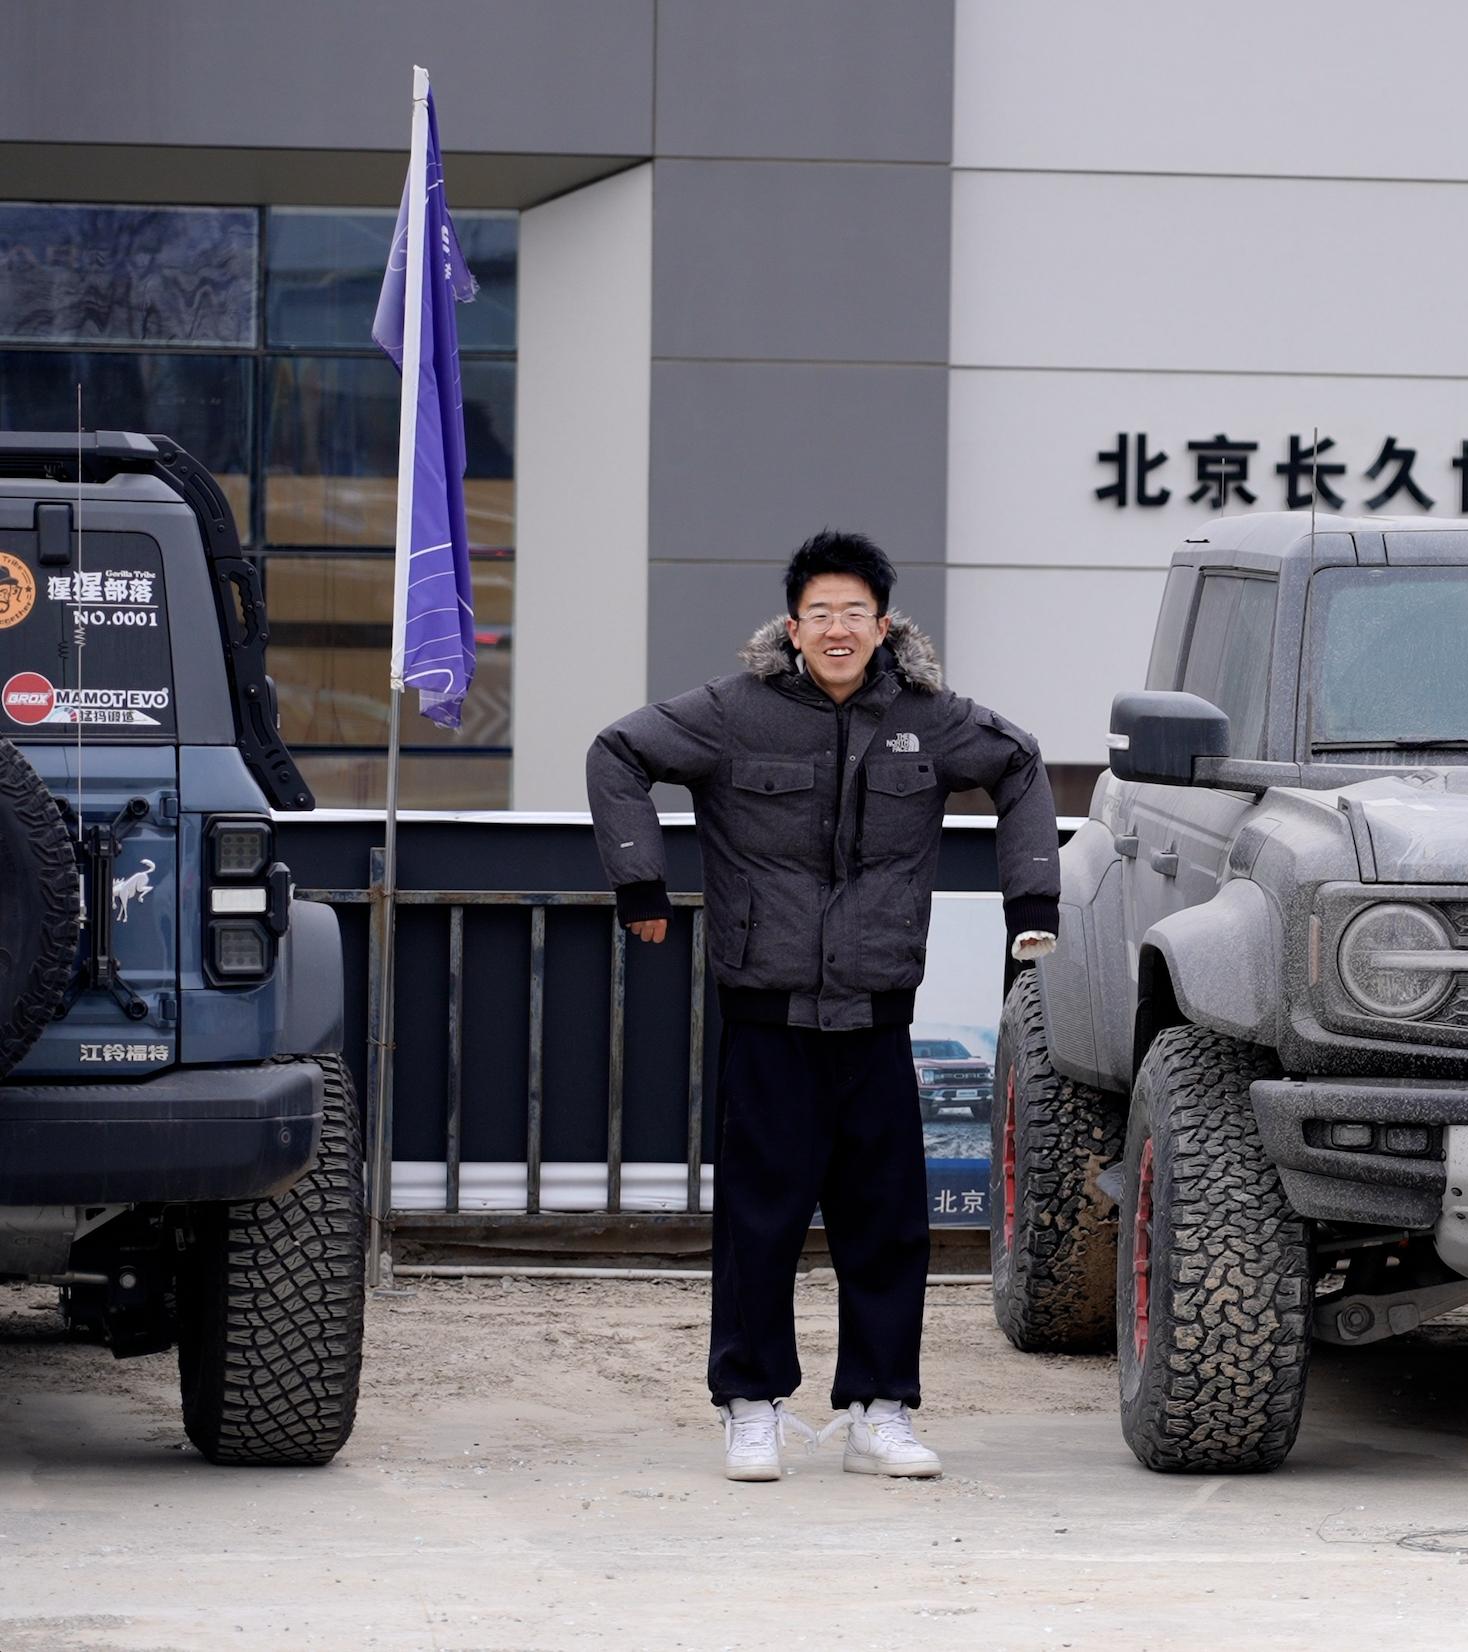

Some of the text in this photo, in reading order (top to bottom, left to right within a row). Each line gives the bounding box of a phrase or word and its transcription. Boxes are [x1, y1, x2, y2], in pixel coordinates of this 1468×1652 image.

[47, 570, 153, 603] 猩猩部落
[73, 610, 158, 627] NO.0001
[57, 690, 166, 706] MAMOT EVO
[80, 1043, 169, 1062] 江铃福特
[933, 1188, 986, 1214] 北京
